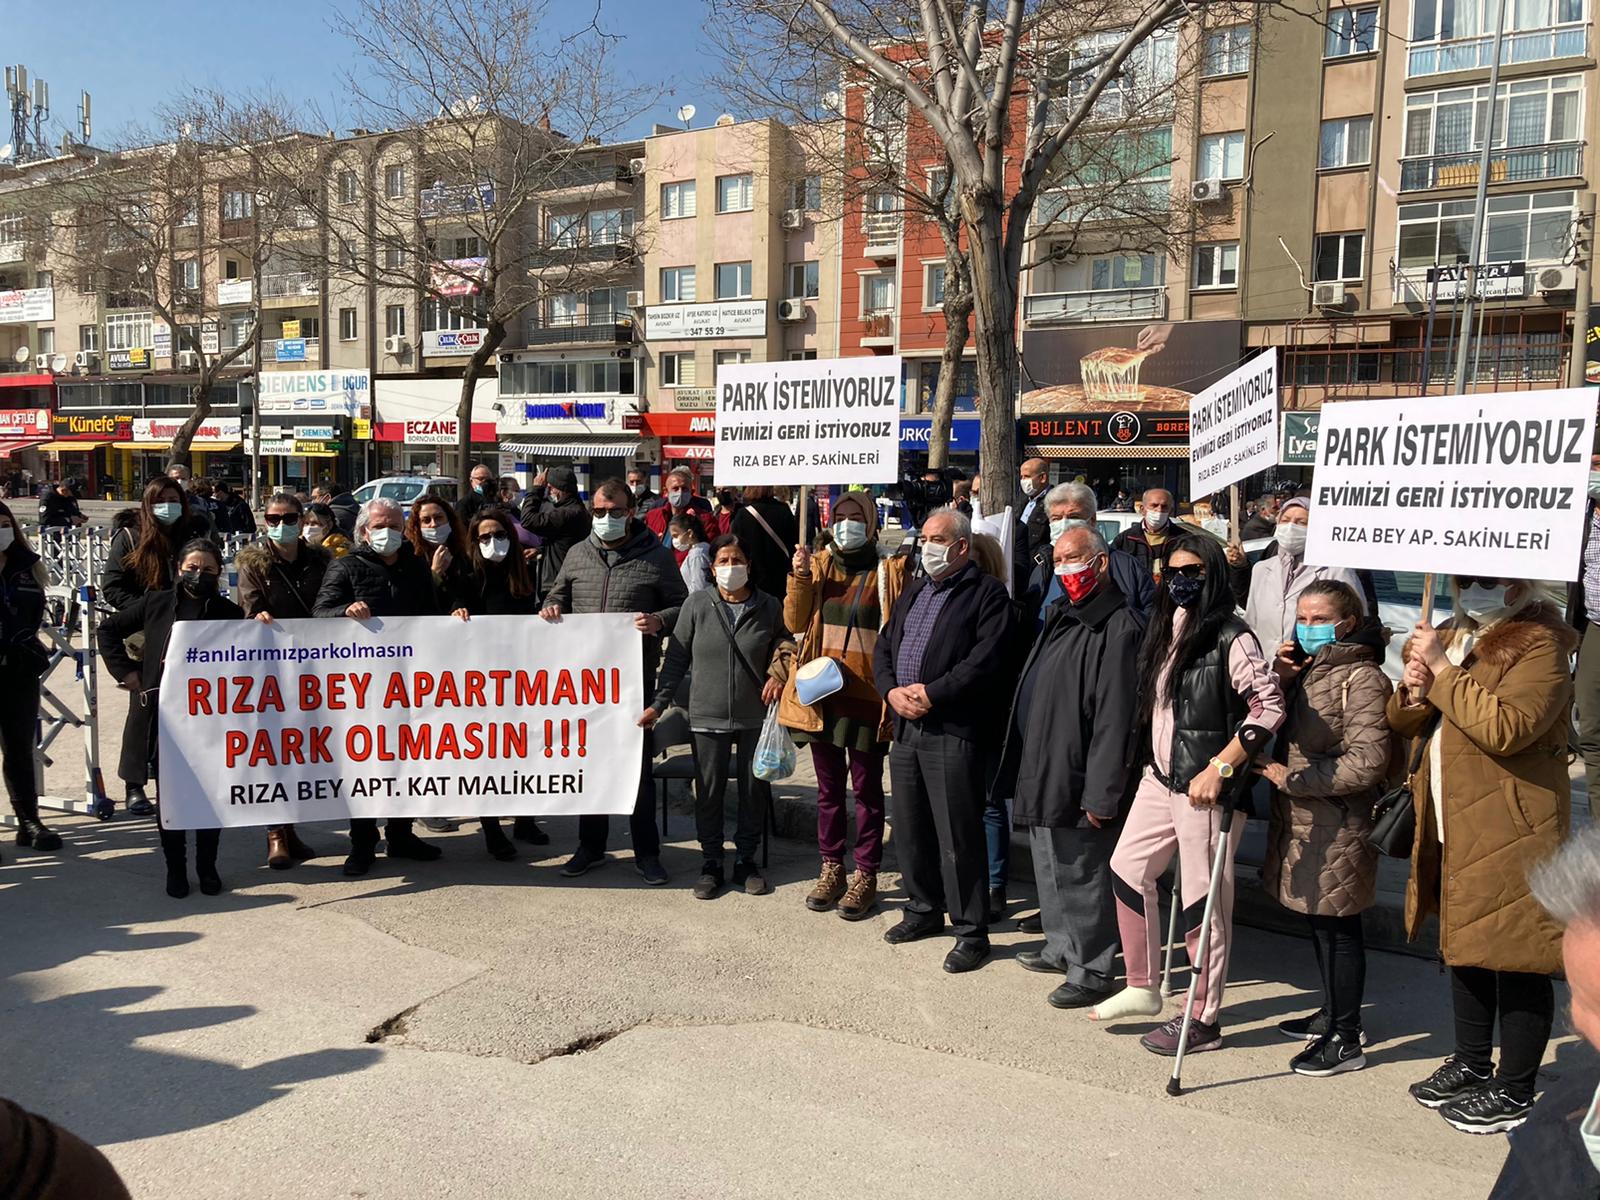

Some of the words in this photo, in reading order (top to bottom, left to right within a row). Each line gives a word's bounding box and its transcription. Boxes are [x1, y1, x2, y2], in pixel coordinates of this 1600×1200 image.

[716, 327, 725, 335] 29
[110, 354, 130, 362] AVUKA
[260, 375, 326, 393] SIEMENS
[722, 382, 768, 412] PARK
[773, 370, 895, 410] İSTEMİYORUZ
[1192, 401, 1213, 438] PARK
[1214, 366, 1273, 424] İSTEMİYORUZ
[70, 416, 114, 432] Künefe
[407, 421, 456, 434] ECZANE
[690, 418, 716, 432] AVAN
[721, 421, 773, 441] EVİMİZİ
[777, 420, 810, 440] GERİ
[814, 419, 891, 439] İSTİYORUZ
[1029, 420, 1102, 436] BÜLENT
[1192, 435, 1216, 463] EVİMİZİ
[1217, 425, 1232, 450] GERİ
[1234, 408, 1273, 440] İSTİYORUZ
[1324, 426, 1389, 466] PARK
[1393, 409, 1585, 466] İSTEMİYORUZ
[685, 449, 714, 458] AVA
[733, 455, 759, 467] RIZA
[763, 455, 786, 466] BEY
[788, 454, 809, 466] AP.
[812, 450, 879, 465] SAKİNLERİ
[1198, 467, 1210, 482] RIZA
[1211, 462, 1222, 476] BEY
[1223, 458, 1232, 469] AP.
[1234, 436, 1268, 465] SAKİNLERİ
[1318, 480, 1390, 507] EVİMİZİ
[1396, 480, 1444, 508] GERİ
[1450, 480, 1574, 510] İSTİYORUZ
[1332, 526, 1367, 543] RIZA
[1372, 528, 1405, 544] BEY
[1409, 529, 1437, 546] AP.
[1443, 526, 1550, 550] SAKİNLERİ
[186, 642, 414, 664] #anılarımızparkolmasın
[187, 674, 285, 716] RIZA
[298, 672, 372, 711] BEY
[382, 668, 620, 708] APARTMANI
[225, 726, 333, 768] PARK
[345, 721, 528, 762] OLMASIN
[543, 718, 587, 759] !!!
[229, 782, 289, 805] RIZA
[299, 778, 344, 801] BEY
[350, 776, 400, 798] APT.
[408, 774, 453, 796] KAT
[458, 768, 584, 796] MALİKLERİ
